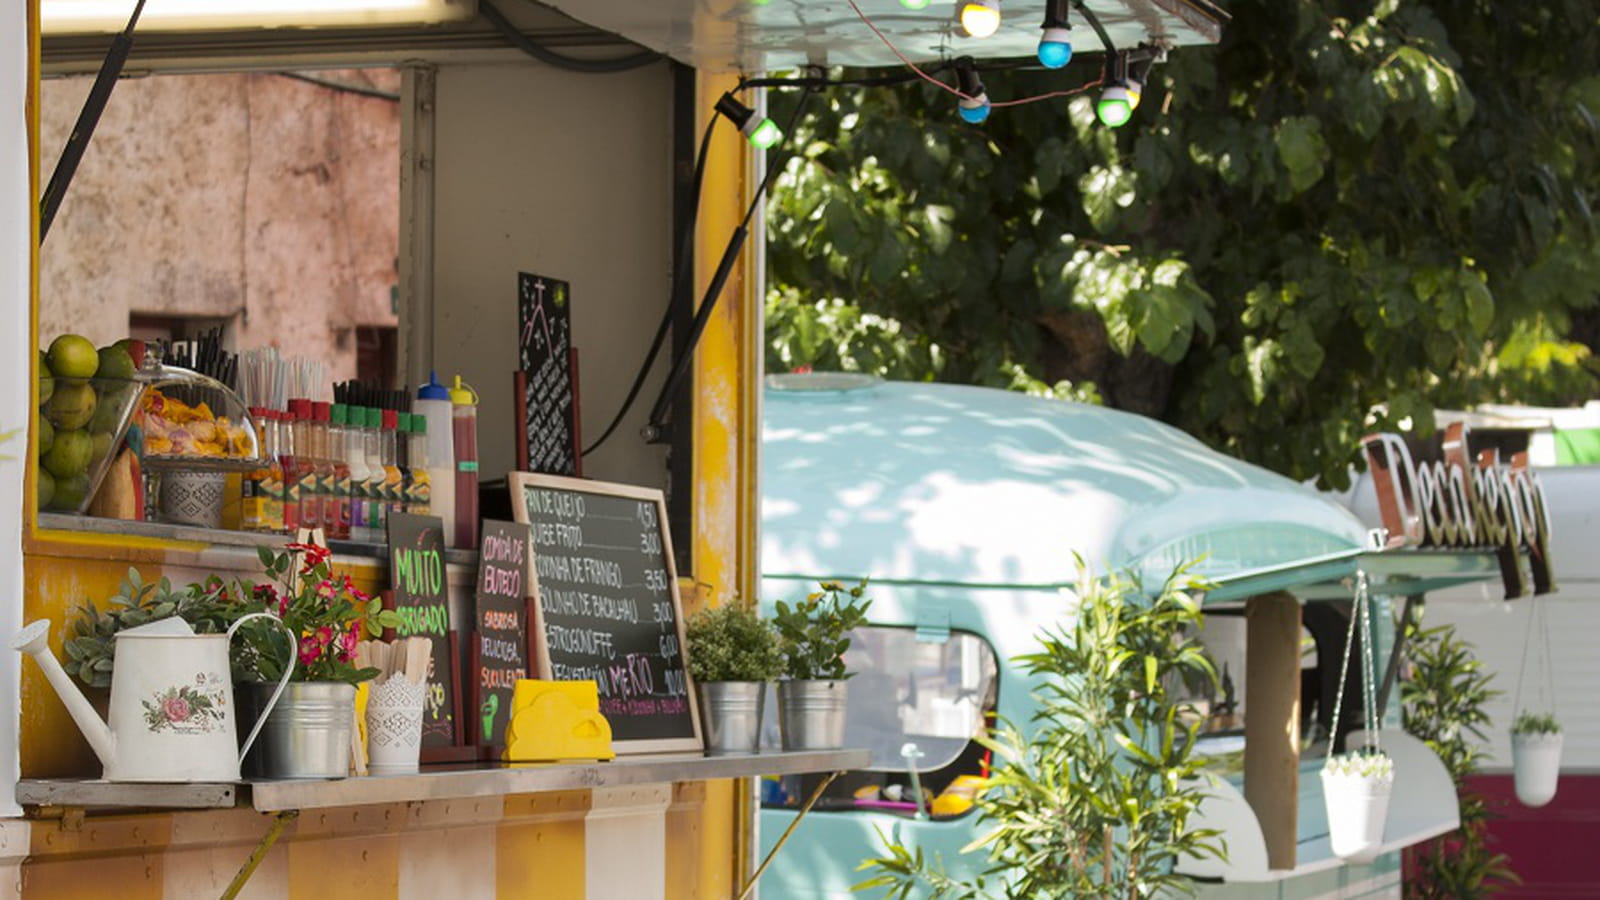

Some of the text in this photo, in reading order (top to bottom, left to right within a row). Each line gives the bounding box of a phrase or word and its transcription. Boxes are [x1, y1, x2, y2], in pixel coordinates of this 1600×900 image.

[541, 490, 554, 514] DE
[556, 522, 583, 552] FRITO
[512, 538, 524, 565] DE
[534, 553, 668, 596] OXINHA DE FRANGO 3,50
[577, 591, 592, 616] DE
